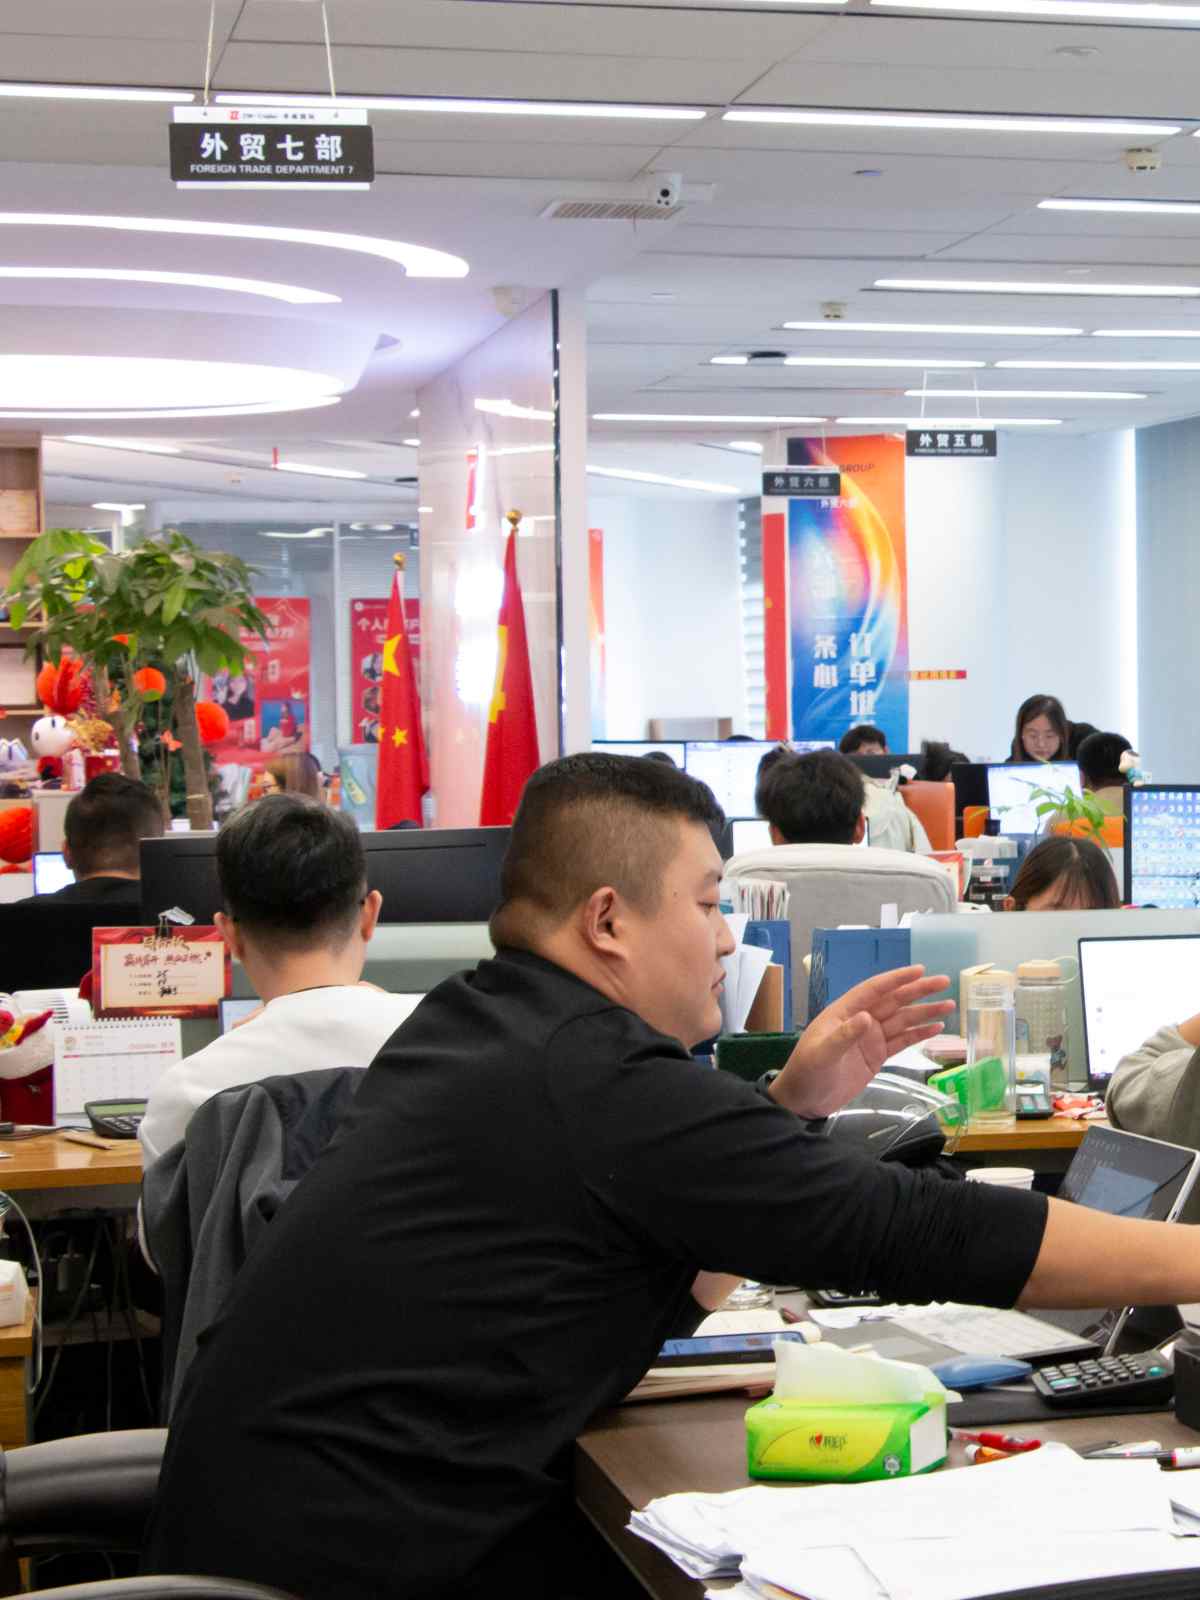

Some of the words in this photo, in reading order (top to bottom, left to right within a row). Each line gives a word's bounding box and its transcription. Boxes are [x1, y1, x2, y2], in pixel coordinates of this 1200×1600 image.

[201, 132, 344, 162] 外贸七部
[190, 164, 237, 174] FOREIGN
[239, 165, 273, 174] TRADE
[275, 165, 344, 175] DEPARTMENT
[919, 432, 984, 448] 外贸五部
[774, 475, 830, 488] 外贸六部
